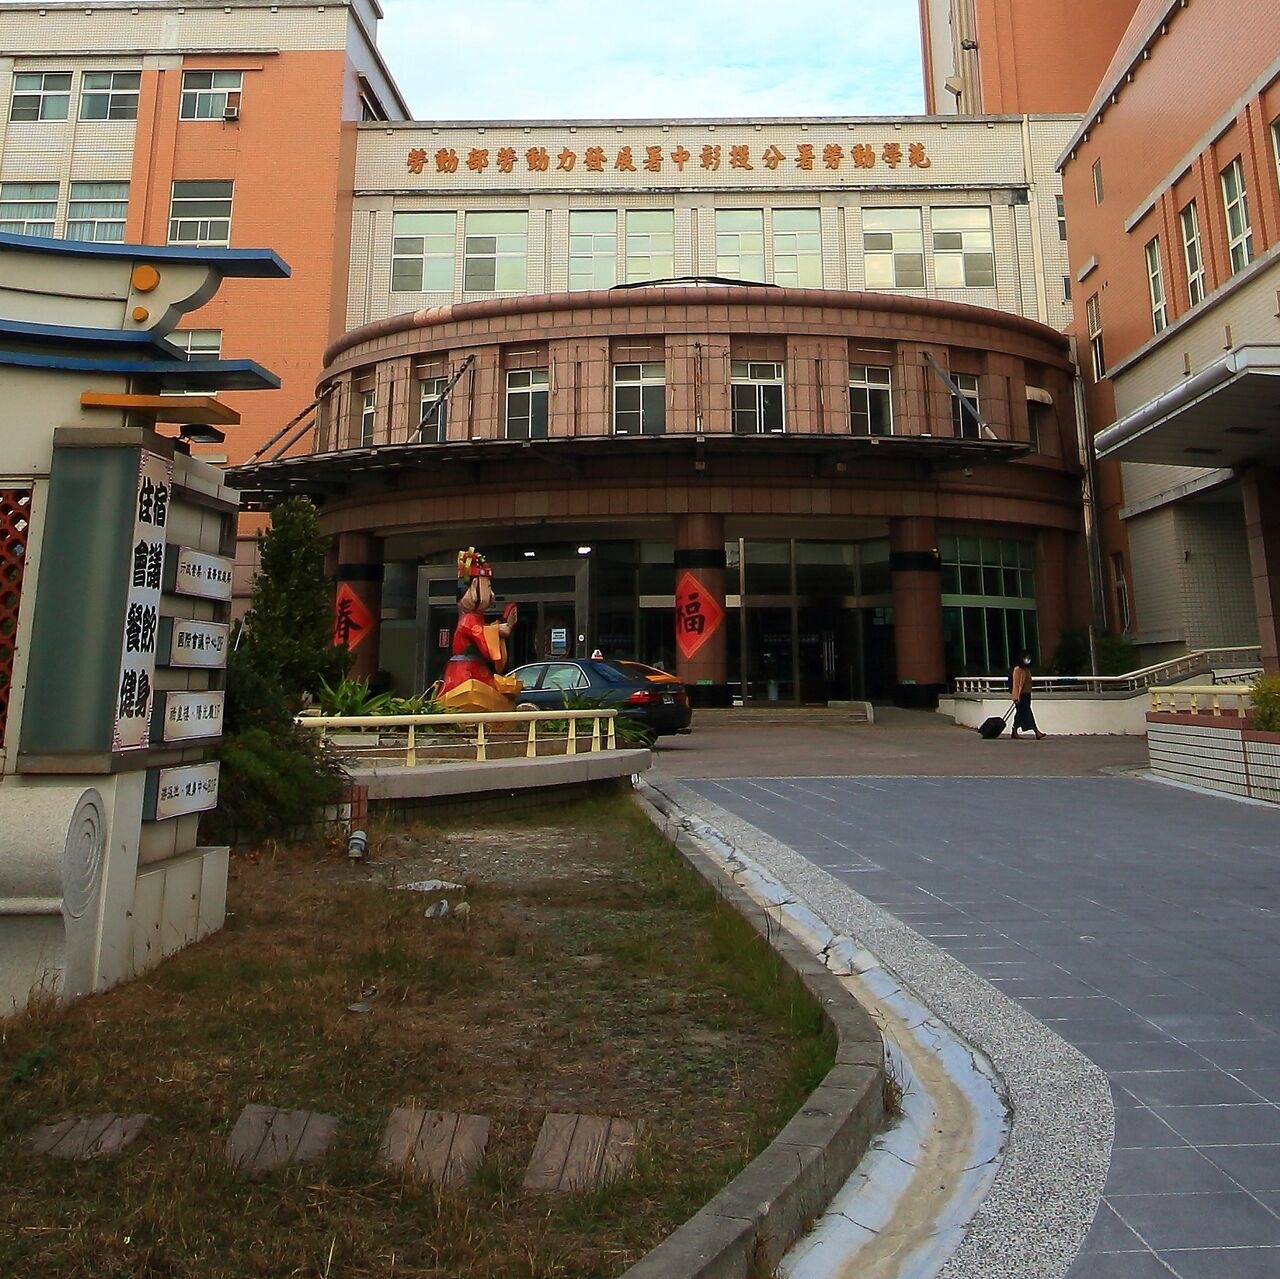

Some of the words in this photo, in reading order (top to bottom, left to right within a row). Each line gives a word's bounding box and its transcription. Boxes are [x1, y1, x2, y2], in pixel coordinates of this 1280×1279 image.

[406, 142, 932, 175] 勞動部勞動力發展署中彰投分署勞動學苑
[137, 476, 168, 528] 住宿
[133, 539, 163, 591] 會議
[126, 602, 157, 654] 餐飲
[676, 592, 706, 635] 福
[119, 669, 151, 720] 健身
